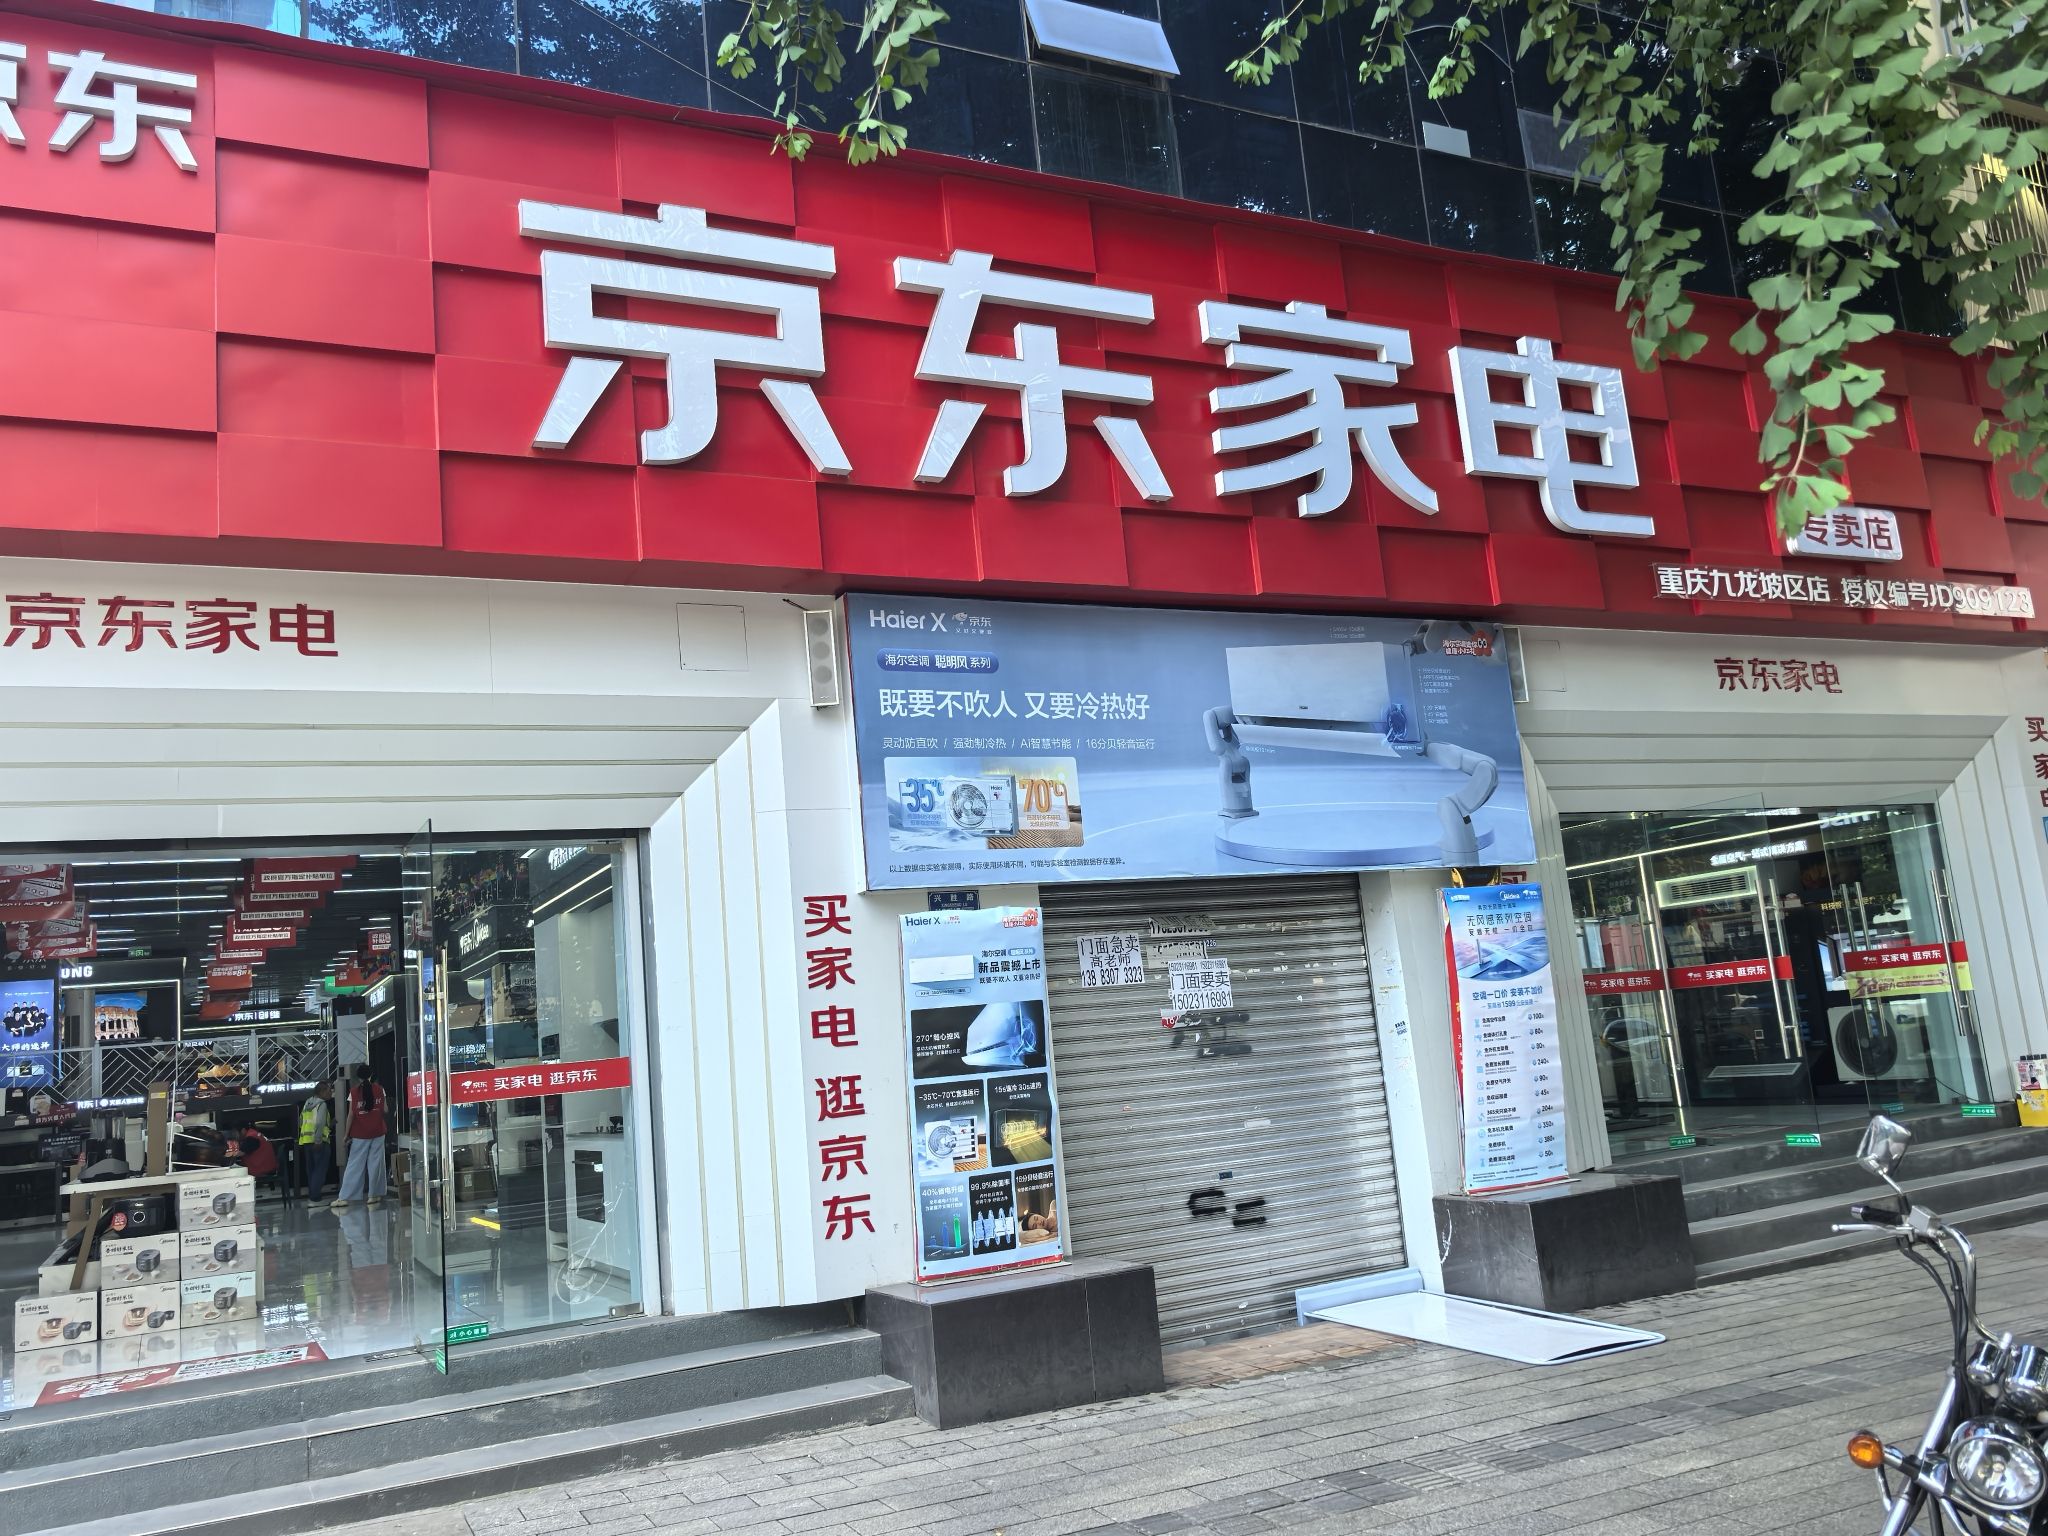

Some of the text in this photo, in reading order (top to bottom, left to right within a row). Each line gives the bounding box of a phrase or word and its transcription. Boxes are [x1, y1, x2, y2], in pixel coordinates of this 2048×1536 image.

[0, 41, 198, 172] 东
[518, 202, 1656, 538] 京东家电
[1804, 510, 1894, 551] 专卖店
[1657, 566, 2032, 614] 重庆九龙坡区店 授权编号JD909123
[3, 591, 339, 657] 京东家电
[869, 609, 926, 630] Haier
[968, 615, 992, 628] 京东
[885, 653, 991, 670] 海尔空调 聪明风系列
[1713, 656, 1843, 694] 京东家电
[879, 688, 1151, 721] 既要不吹人 又要冷热好
[882, 737, 938, 750] 灵动防直吹
[953, 737, 1007, 750] 强劲制冷热
[1085, 738, 1156, 751] 16分贝轻音运行
[905, 915, 931, 927] Haier
[1466, 911, 1532, 927] 无风感系列空调
[1080, 934, 1140, 956] 门面急卖
[978, 958, 1041, 974] 新品震撼上市
[1090, 953, 1131, 969] 高老师
[1881, 949, 1942, 964] 买家电 逛京东
[979, 975, 1011, 985] 既要不吹人
[1081, 966, 1144, 987] 138 8307 3323
[1170, 970, 1231, 990] 门面要卖
[1600, 976, 1652, 989] 买家电 逛京东
[1705, 965, 1767, 980] 买家电 逛京东
[1172, 990, 1232, 1011] 15023116981
[1472, 985, 1543, 1001] 空调一口价 安装不加价
[803, 894, 876, 1241] 买家电 逛京东
[472, 1080, 488, 1089] 京东
[494, 1068, 598, 1091] 买家电 逛京东
